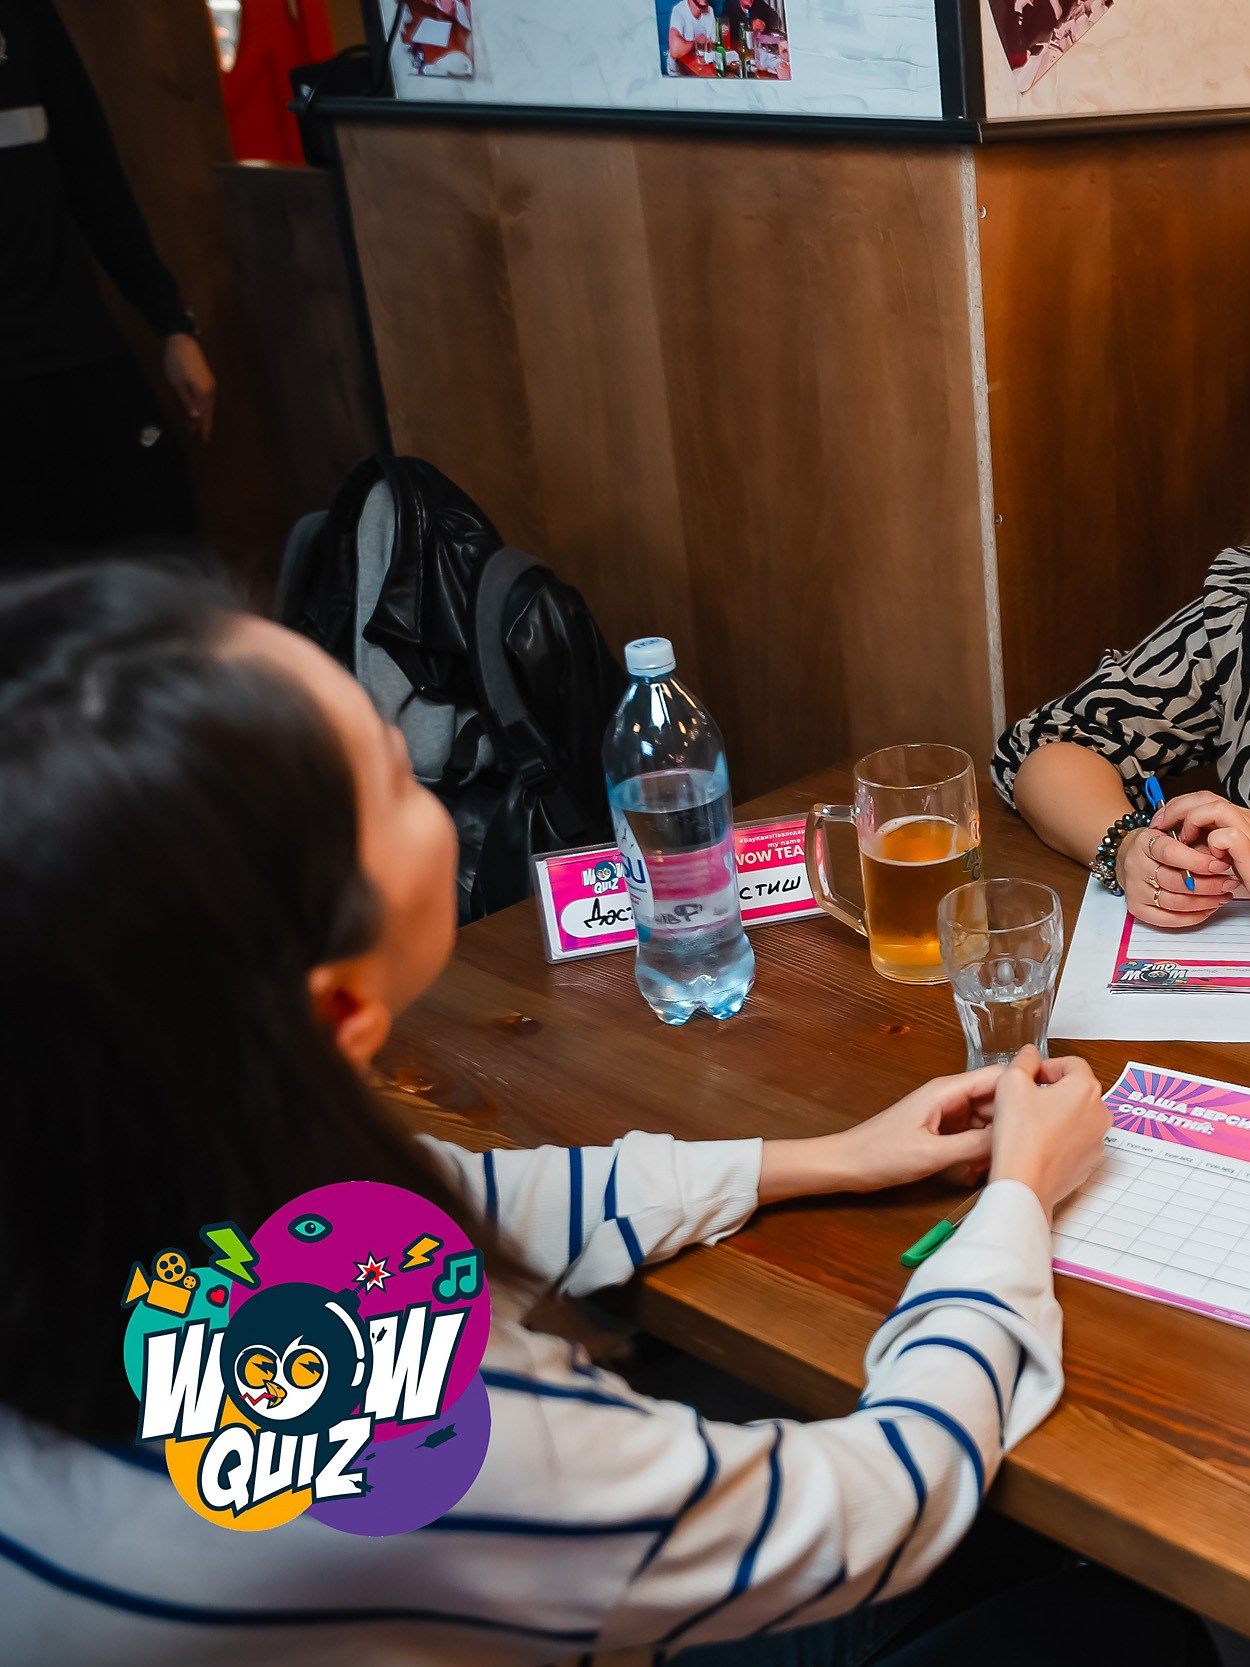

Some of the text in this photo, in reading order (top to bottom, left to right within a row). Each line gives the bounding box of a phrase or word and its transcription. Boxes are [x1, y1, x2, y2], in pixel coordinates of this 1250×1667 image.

[780, 839, 801, 847] name
[593, 878, 619, 894] QUIZ
[1141, 963, 1176, 972] QUIZ
[1127, 1091, 1189, 1114] ВАША
[1118, 1103, 1216, 1136] СОБЫТИЙ:
